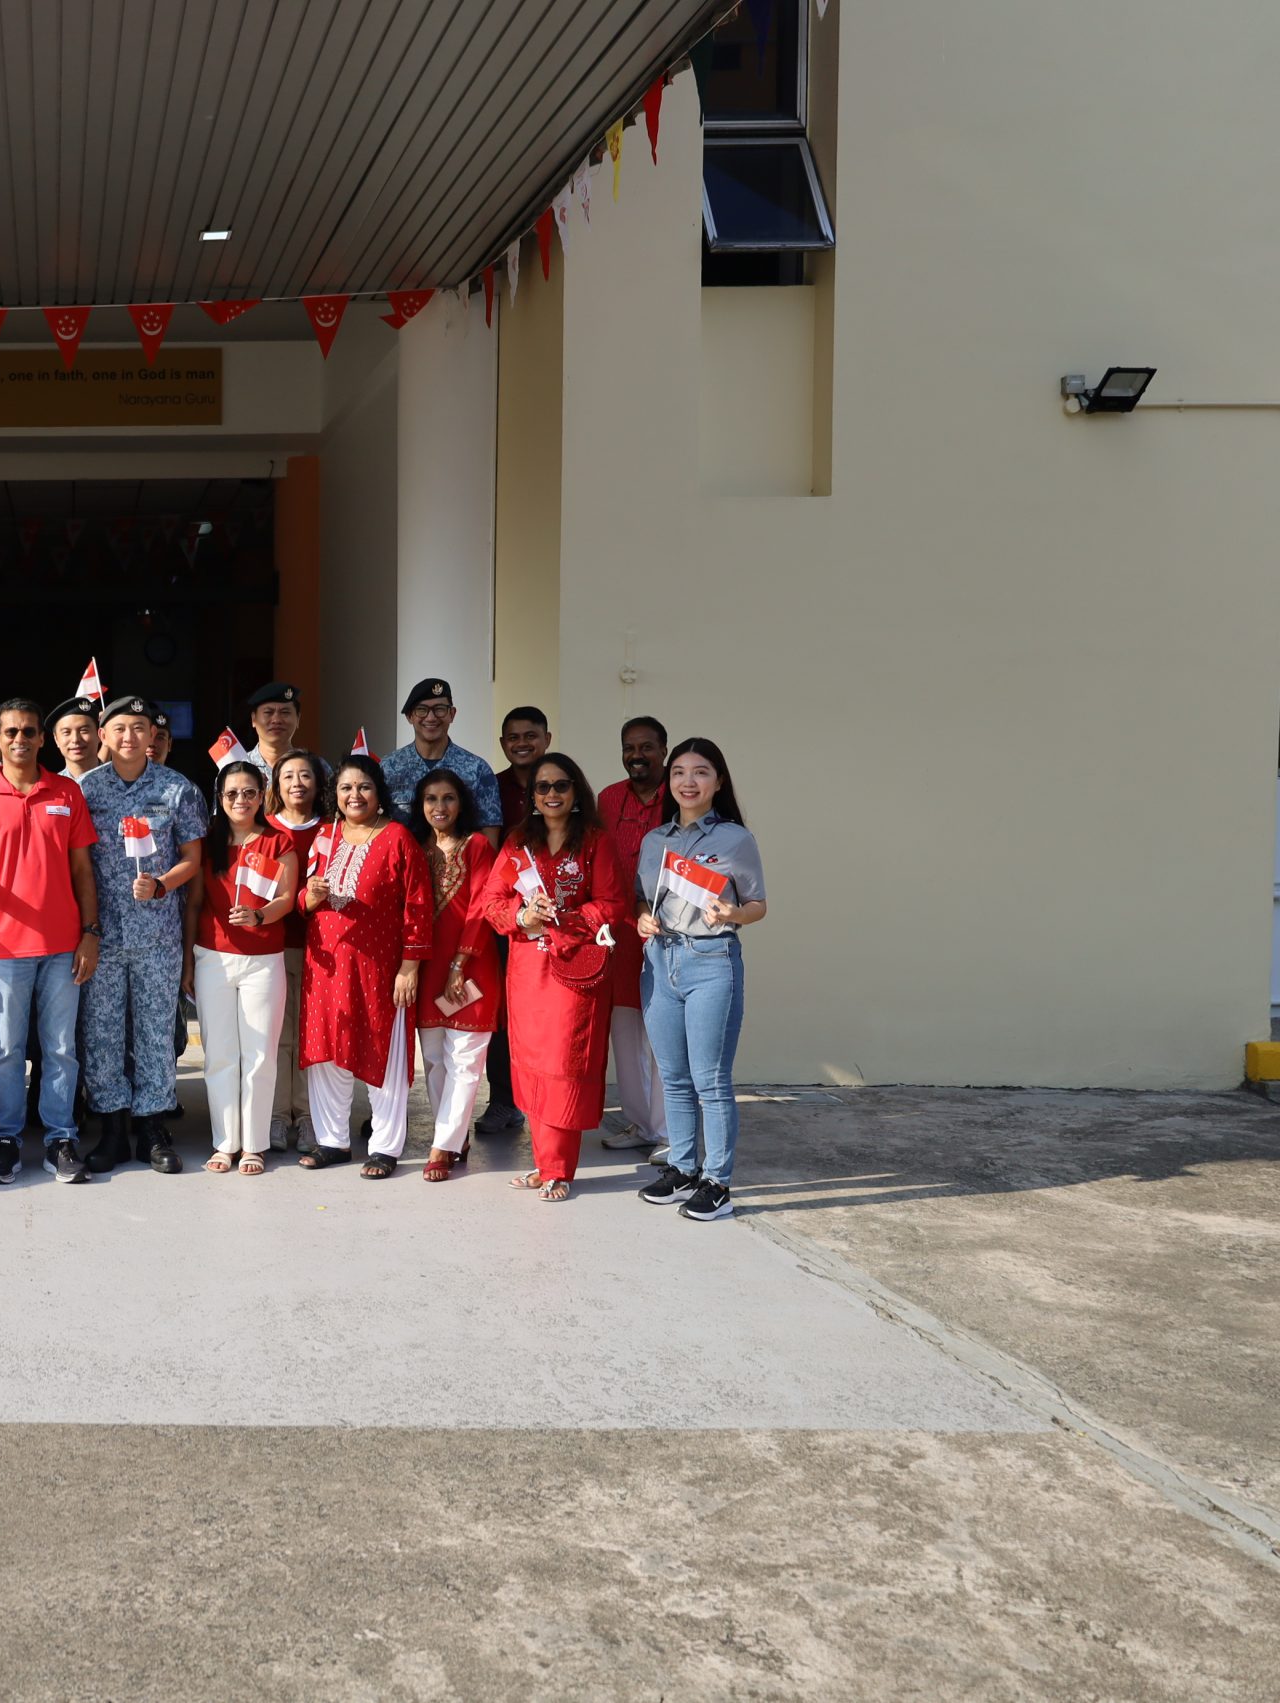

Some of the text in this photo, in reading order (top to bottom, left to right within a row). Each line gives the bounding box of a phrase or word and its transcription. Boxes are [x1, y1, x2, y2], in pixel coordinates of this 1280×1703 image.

[9, 372, 32, 381] one
[38, 370, 50, 381] in
[54, 369, 87, 382] faith,
[92, 371, 117, 381] one
[121, 369, 133, 380] in
[138, 369, 166, 380] God
[170, 369, 181, 380] is
[185, 370, 215, 380] man
[119, 392, 215, 406] Narayana Guru
